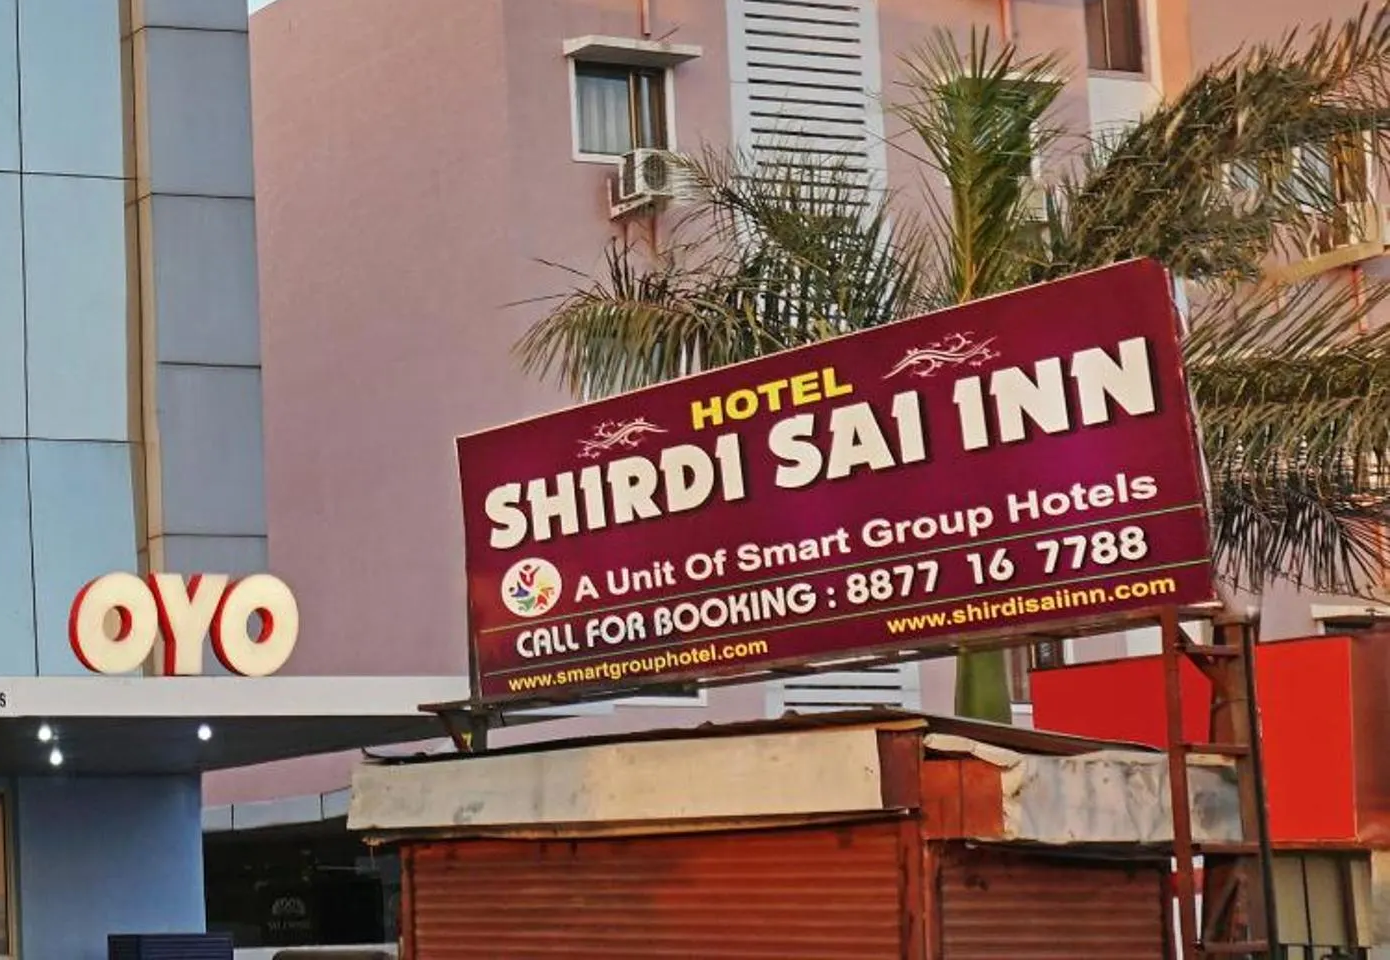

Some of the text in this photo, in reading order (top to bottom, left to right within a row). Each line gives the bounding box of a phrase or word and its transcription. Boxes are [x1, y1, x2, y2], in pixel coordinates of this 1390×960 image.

[484, 336, 1156, 550] SHIRDI SAI INN
[690, 367, 853, 431] HOTEL
[575, 472, 1158, 603] A Unit Of Smart Group Hotels
[68, 572, 299, 677] OYO
[516, 623, 580, 658] CALL
[586, 612, 646, 649] FOR
[654, 583, 816, 636] BOOKING
[845, 560, 940, 605] 8877
[966, 548, 1015, 585] 16
[1035, 525, 1148, 573] 7788
[886, 576, 1176, 634] www.shirdisaiinn.com
[508, 640, 768, 691] www.smartgrouphotel.com
